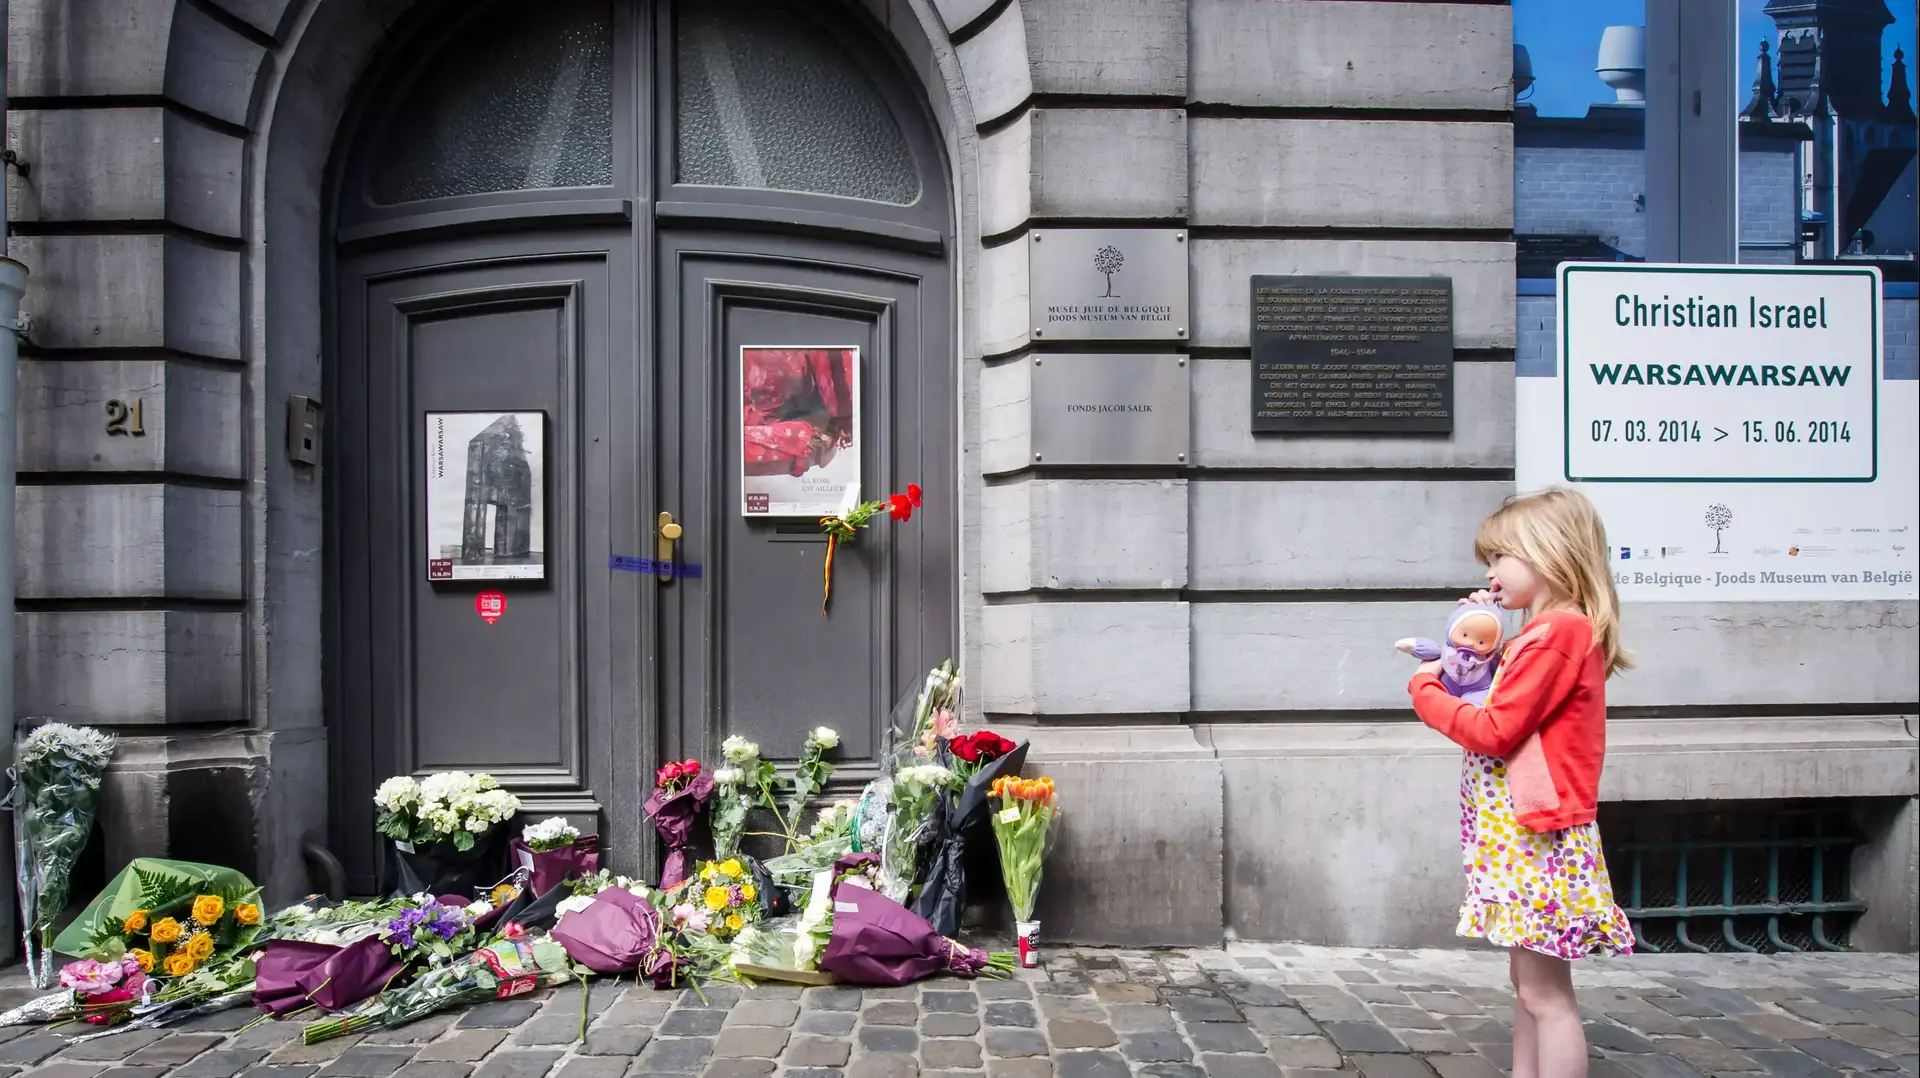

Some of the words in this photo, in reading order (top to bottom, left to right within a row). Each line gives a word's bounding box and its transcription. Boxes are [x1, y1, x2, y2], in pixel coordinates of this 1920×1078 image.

[1048, 305, 1080, 313] MUSÉE
[1083, 306, 1104, 314] JUIF
[1124, 305, 1172, 314] BELGIQUE
[1048, 314, 1077, 323] JOODS
[1615, 294, 1738, 328] Christian
[1749, 296, 1828, 329] Israel
[1589, 363, 1852, 387] WARSAWARSAW
[105, 397, 145, 437] 21
[1067, 404, 1097, 412] FONDS
[1098, 405, 1126, 413] JACOB
[1127, 404, 1153, 412] SALIK
[1591, 420, 1618, 443] 07.
[1624, 420, 1651, 443] 03.
[1658, 420, 1702, 443] 2014
[1742, 421, 1768, 443] 15.
[1774, 421, 1801, 443] 06.
[1808, 421, 1851, 443] 2014
[1612, 572, 1630, 585] de
[1633, 571, 1703, 588] Belgique
[1714, 571, 1757, 587] Joods
[1759, 571, 1828, 584] Museum
[1831, 574, 1859, 583] van
[1862, 570, 1913, 586] België
